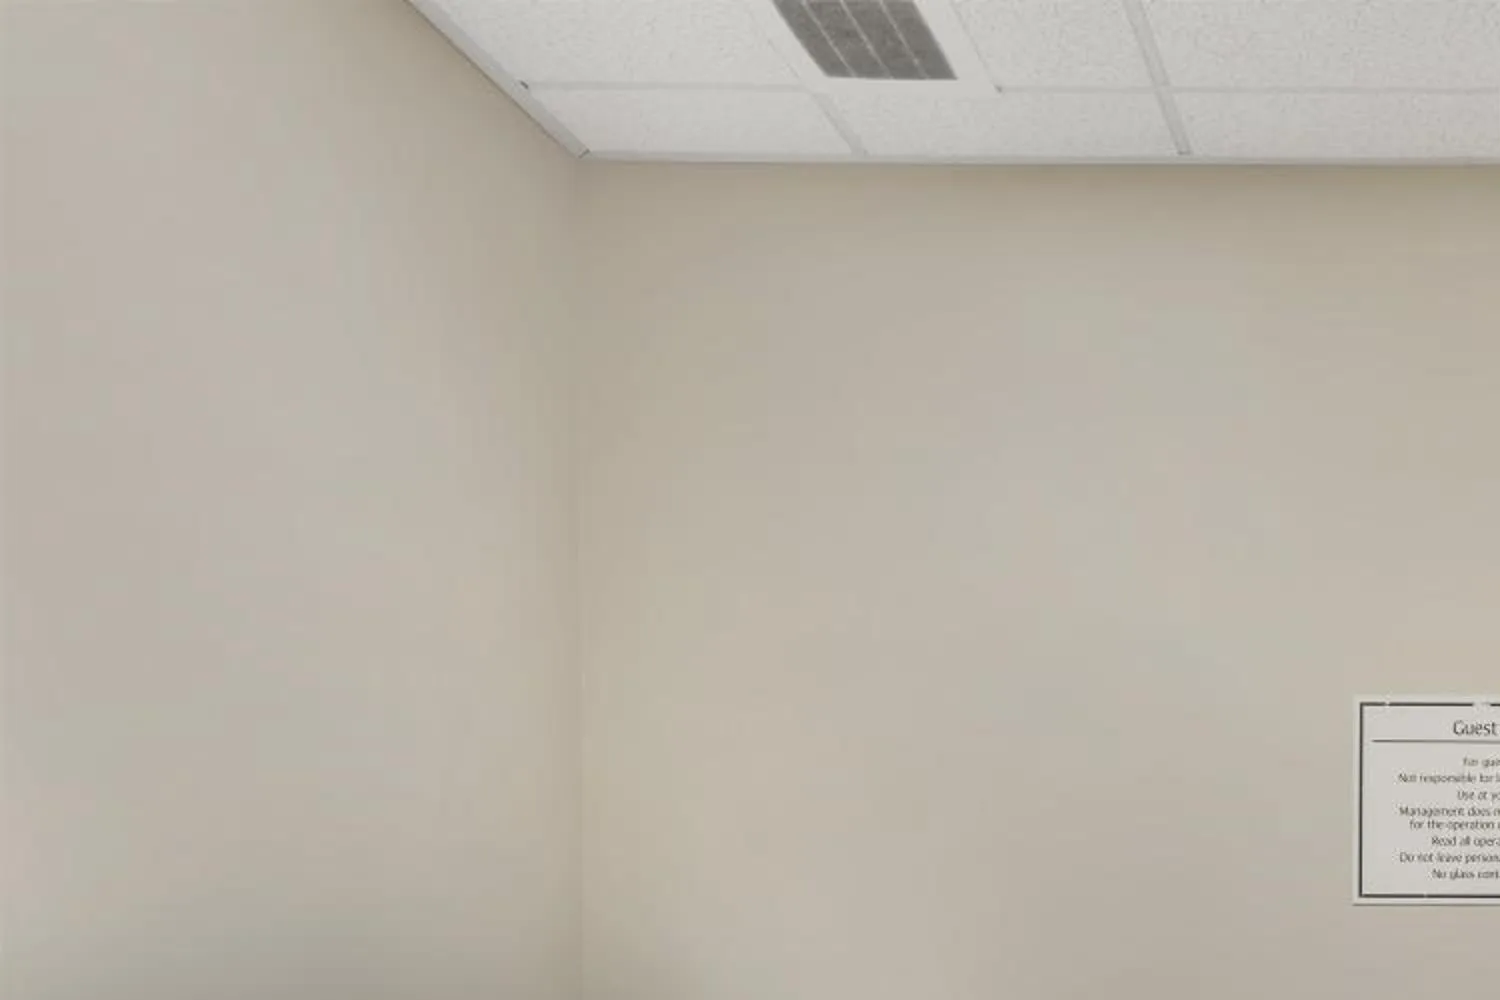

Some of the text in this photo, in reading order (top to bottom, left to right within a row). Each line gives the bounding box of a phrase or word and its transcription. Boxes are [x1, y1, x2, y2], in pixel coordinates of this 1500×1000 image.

[1453, 720, 1497, 736] Guest
[1399, 773, 1417, 783] Not
[1420, 773, 1476, 786] responsible
[1479, 773, 1494, 783] for
[1457, 790, 1476, 800] Use
[1478, 791, 1489, 800] at
[1399, 806, 1466, 819] Management
[1467, 807, 1491, 817] does
[1409, 819, 1424, 830] for
[1427, 820, 1444, 830] the
[1446, 820, 1494, 832] operation
[1431, 836, 1457, 847] Read
[1459, 836, 1471, 847] all
[1399, 852, 1415, 862] Do
[1417, 853, 1434, 863] not
[1437, 852, 1462, 863] leave
[1432, 868, 1447, 879] No
[1449, 868, 1476, 881] glass
